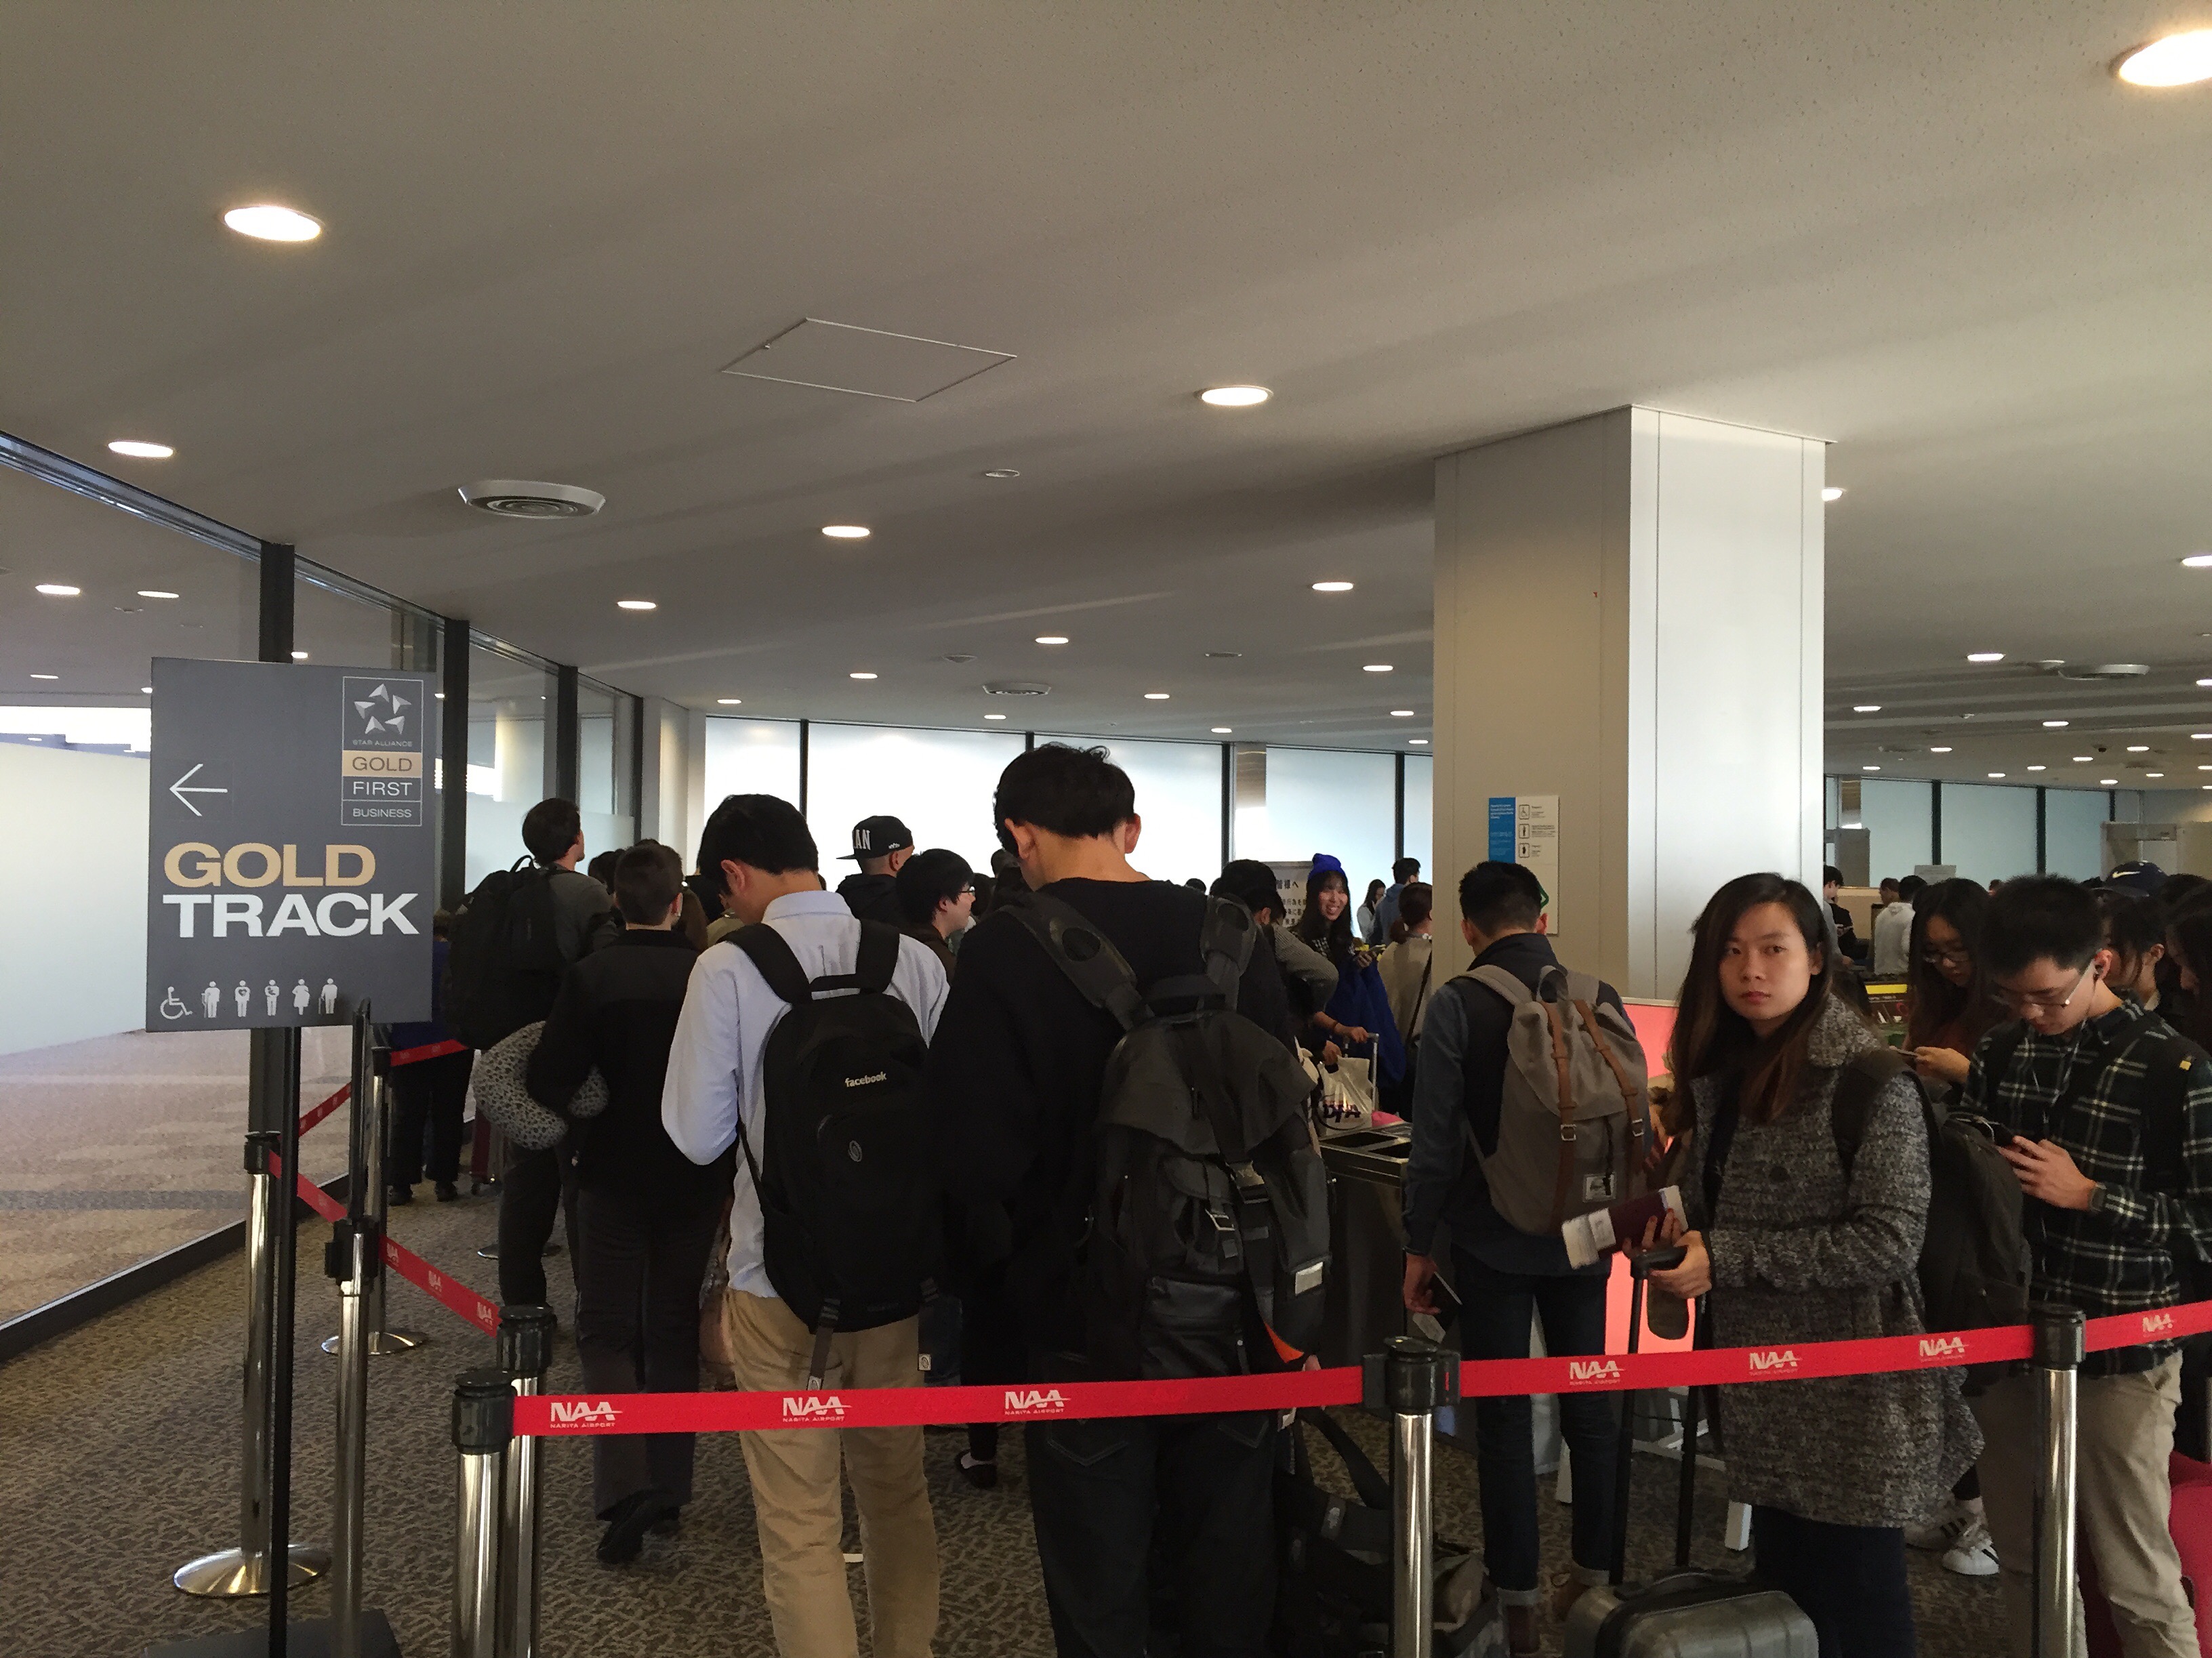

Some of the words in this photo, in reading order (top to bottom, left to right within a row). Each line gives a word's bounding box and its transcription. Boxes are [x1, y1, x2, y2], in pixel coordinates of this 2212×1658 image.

[352, 757, 412, 771] GOLD
[353, 781, 413, 796] FIRST
[352, 808, 412, 818] BUSINESS
[163, 842, 375, 888] GOLD
[163, 892, 419, 938] TRACK
[844, 1071, 887, 1087] facebook
[1919, 1336, 1969, 1356] NAA
[1749, 1350, 1803, 1369] NAA
[1570, 1361, 1625, 1380] NAA
[783, 1396, 852, 1416] NAA
[1004, 1390, 1071, 1409] NAA
[550, 1401, 623, 1422] NAA
